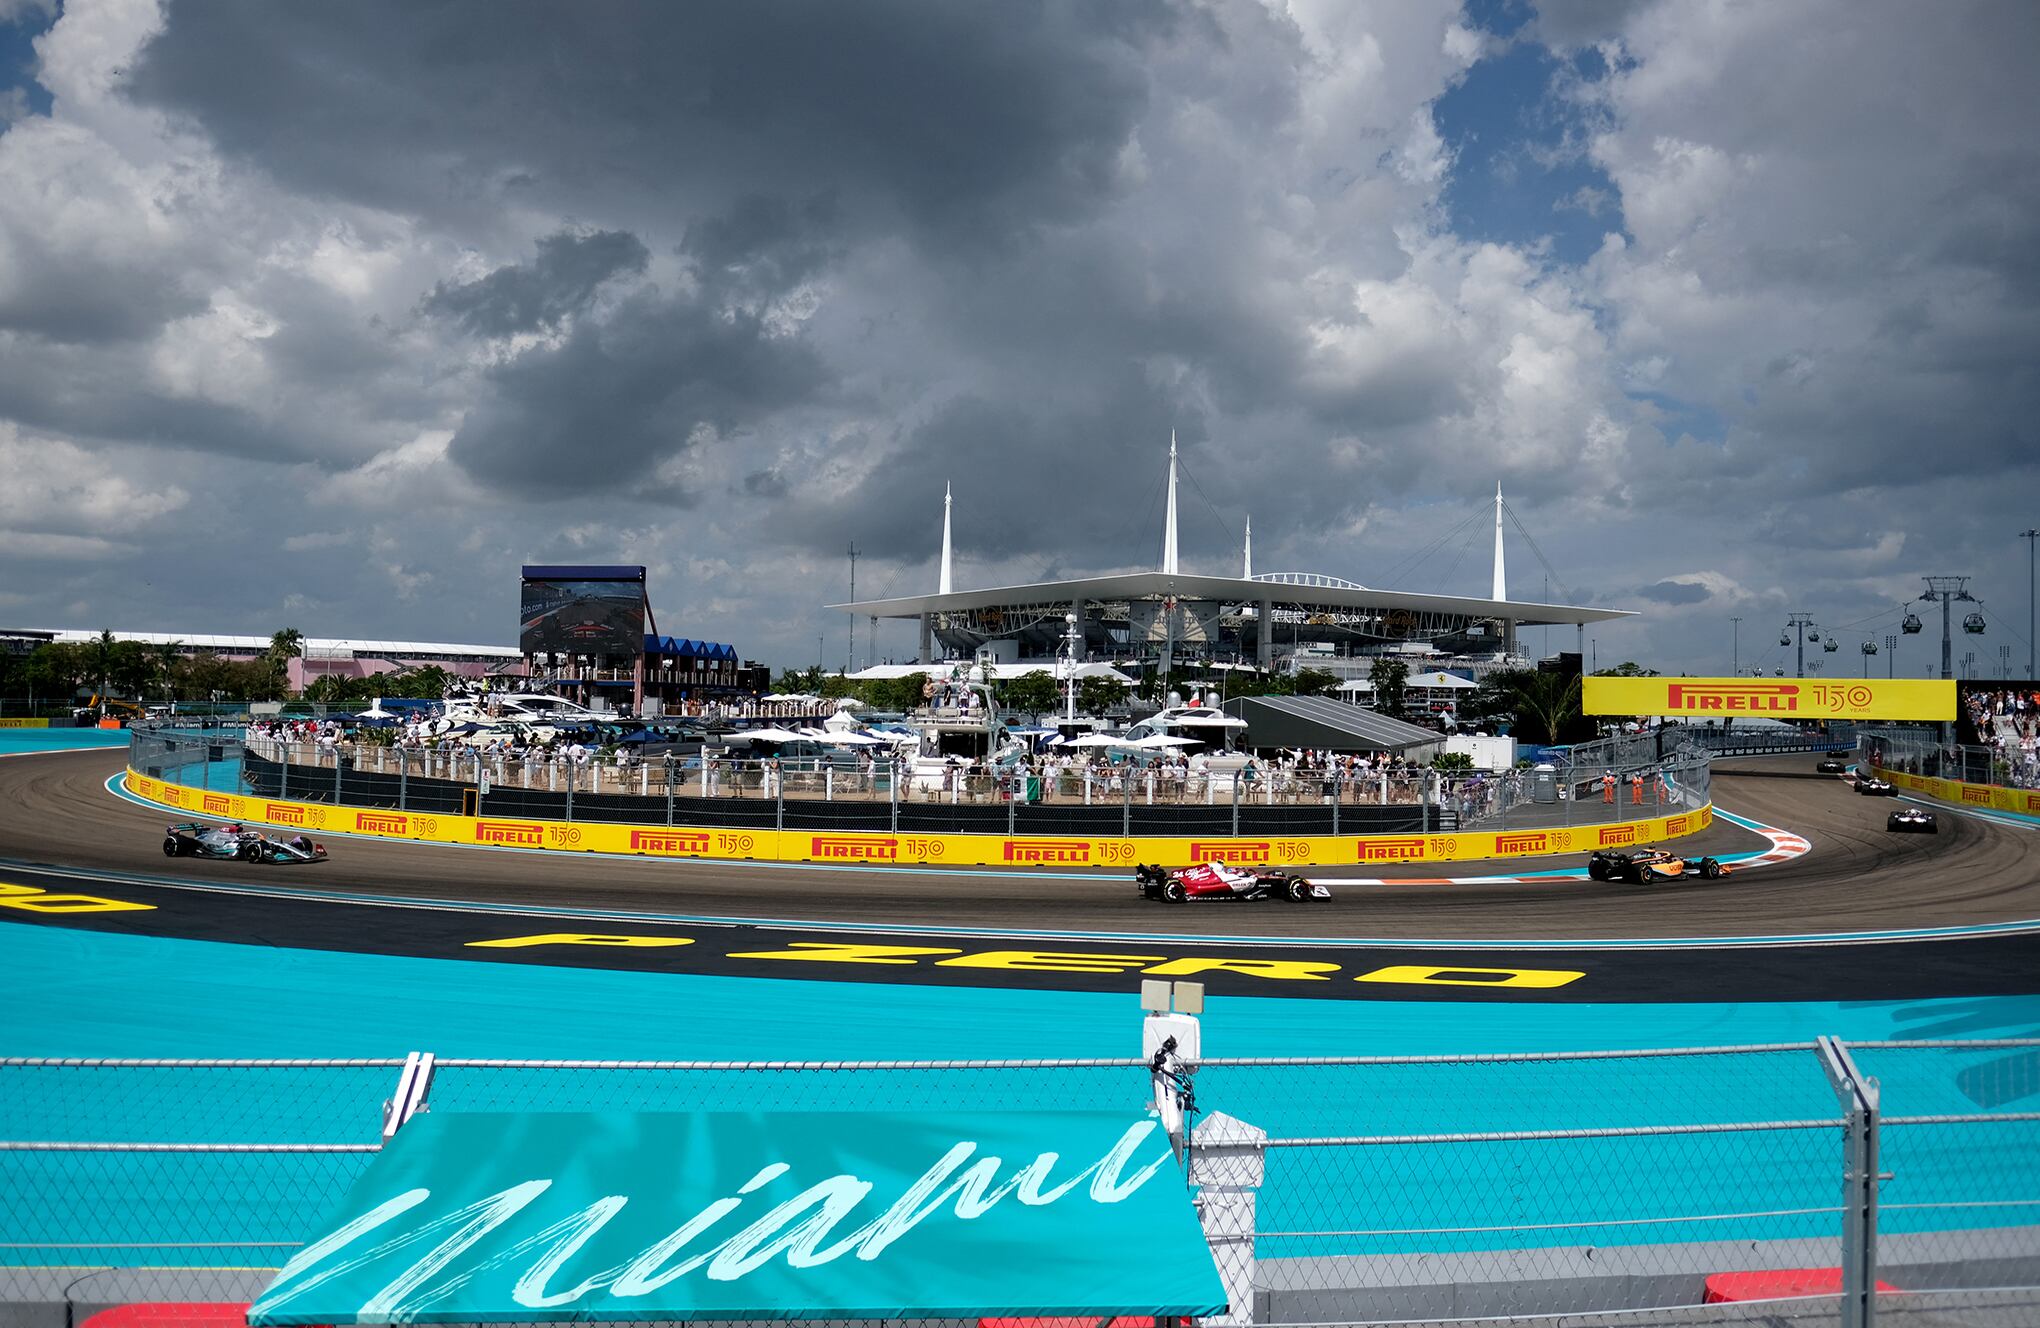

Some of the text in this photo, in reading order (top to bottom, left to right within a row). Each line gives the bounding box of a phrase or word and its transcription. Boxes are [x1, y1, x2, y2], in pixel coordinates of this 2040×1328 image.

[1668, 684, 1872, 712] PIRELLI 150
[204, 795, 230, 814] PIRELLI
[1963, 787, 1991, 803] PIRELLI
[266, 804, 326, 825] PIRELLI 150
[356, 813, 438, 836] PIRELLI 150
[476, 822, 581, 845] PIRELLI 150
[1600, 826, 1634, 845] PIRELLI
[1666, 818, 1687, 836] PIRELLI
[631, 830, 754, 854] PIRELLI 150
[812, 837, 945, 859] PIRELLI 150
[1003, 841, 1136, 862] PIRELLI 150
[1191, 842, 1311, 862] PIRELLI 150
[1357, 838, 1457, 859] PIRELLI 150
[1496, 832, 1572, 854] PIRELLI 150
[465, 933, 1586, 989] P ZERO
[246, 1108, 1174, 1326] Miami
